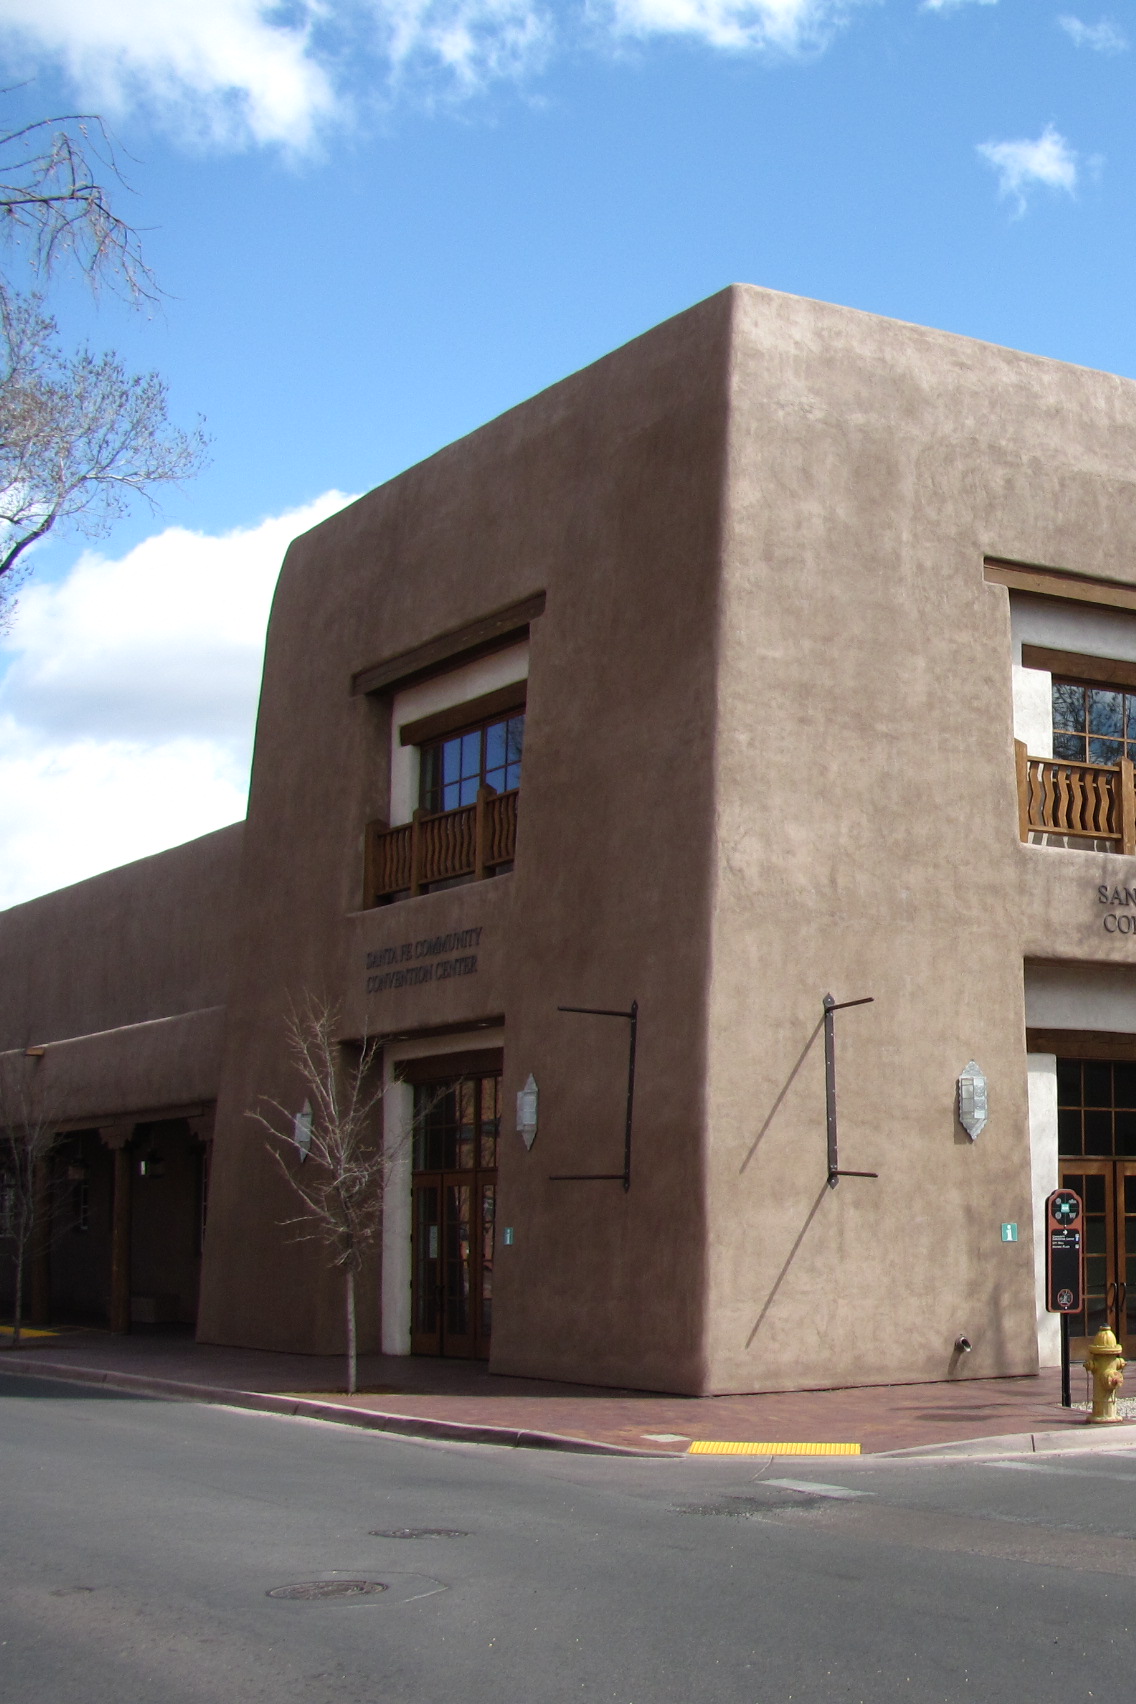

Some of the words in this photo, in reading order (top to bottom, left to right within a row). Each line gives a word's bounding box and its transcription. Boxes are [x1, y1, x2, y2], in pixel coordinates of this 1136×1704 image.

[367, 948, 398, 969] SANTA
[400, 943, 413, 962] FE
[415, 926, 483, 958] COMMUNITY
[367, 964, 433, 993] CONVENTION
[435, 955, 478, 980] CENTER
